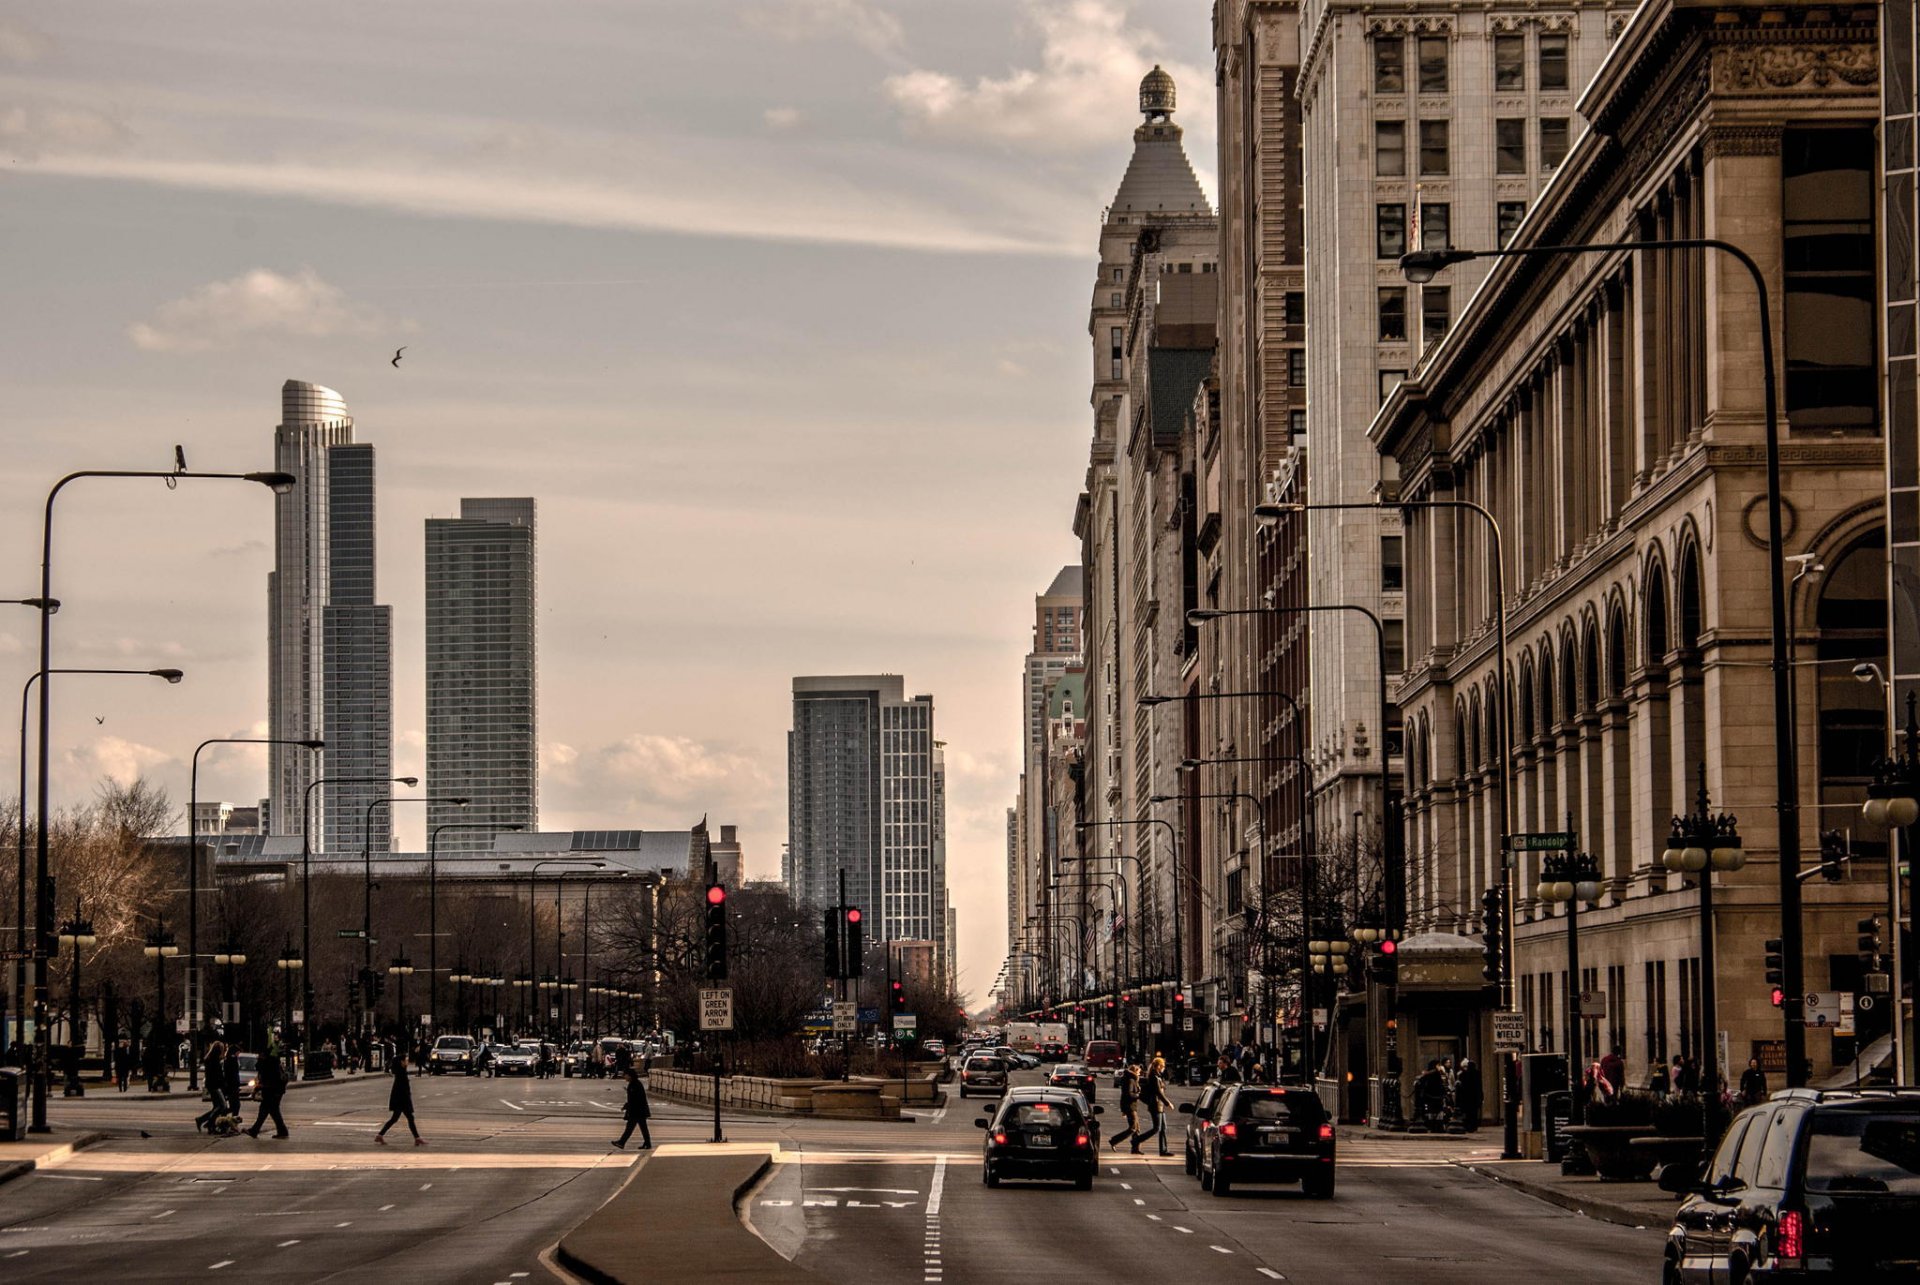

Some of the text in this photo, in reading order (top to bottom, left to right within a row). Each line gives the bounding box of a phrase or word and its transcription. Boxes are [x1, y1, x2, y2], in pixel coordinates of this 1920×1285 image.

[701, 991, 730, 1000] LEFT ON
[705, 1000, 727, 1009] GREEN
[705, 1009, 728, 1017] ARROW
[708, 1018, 725, 1026] ONLY
